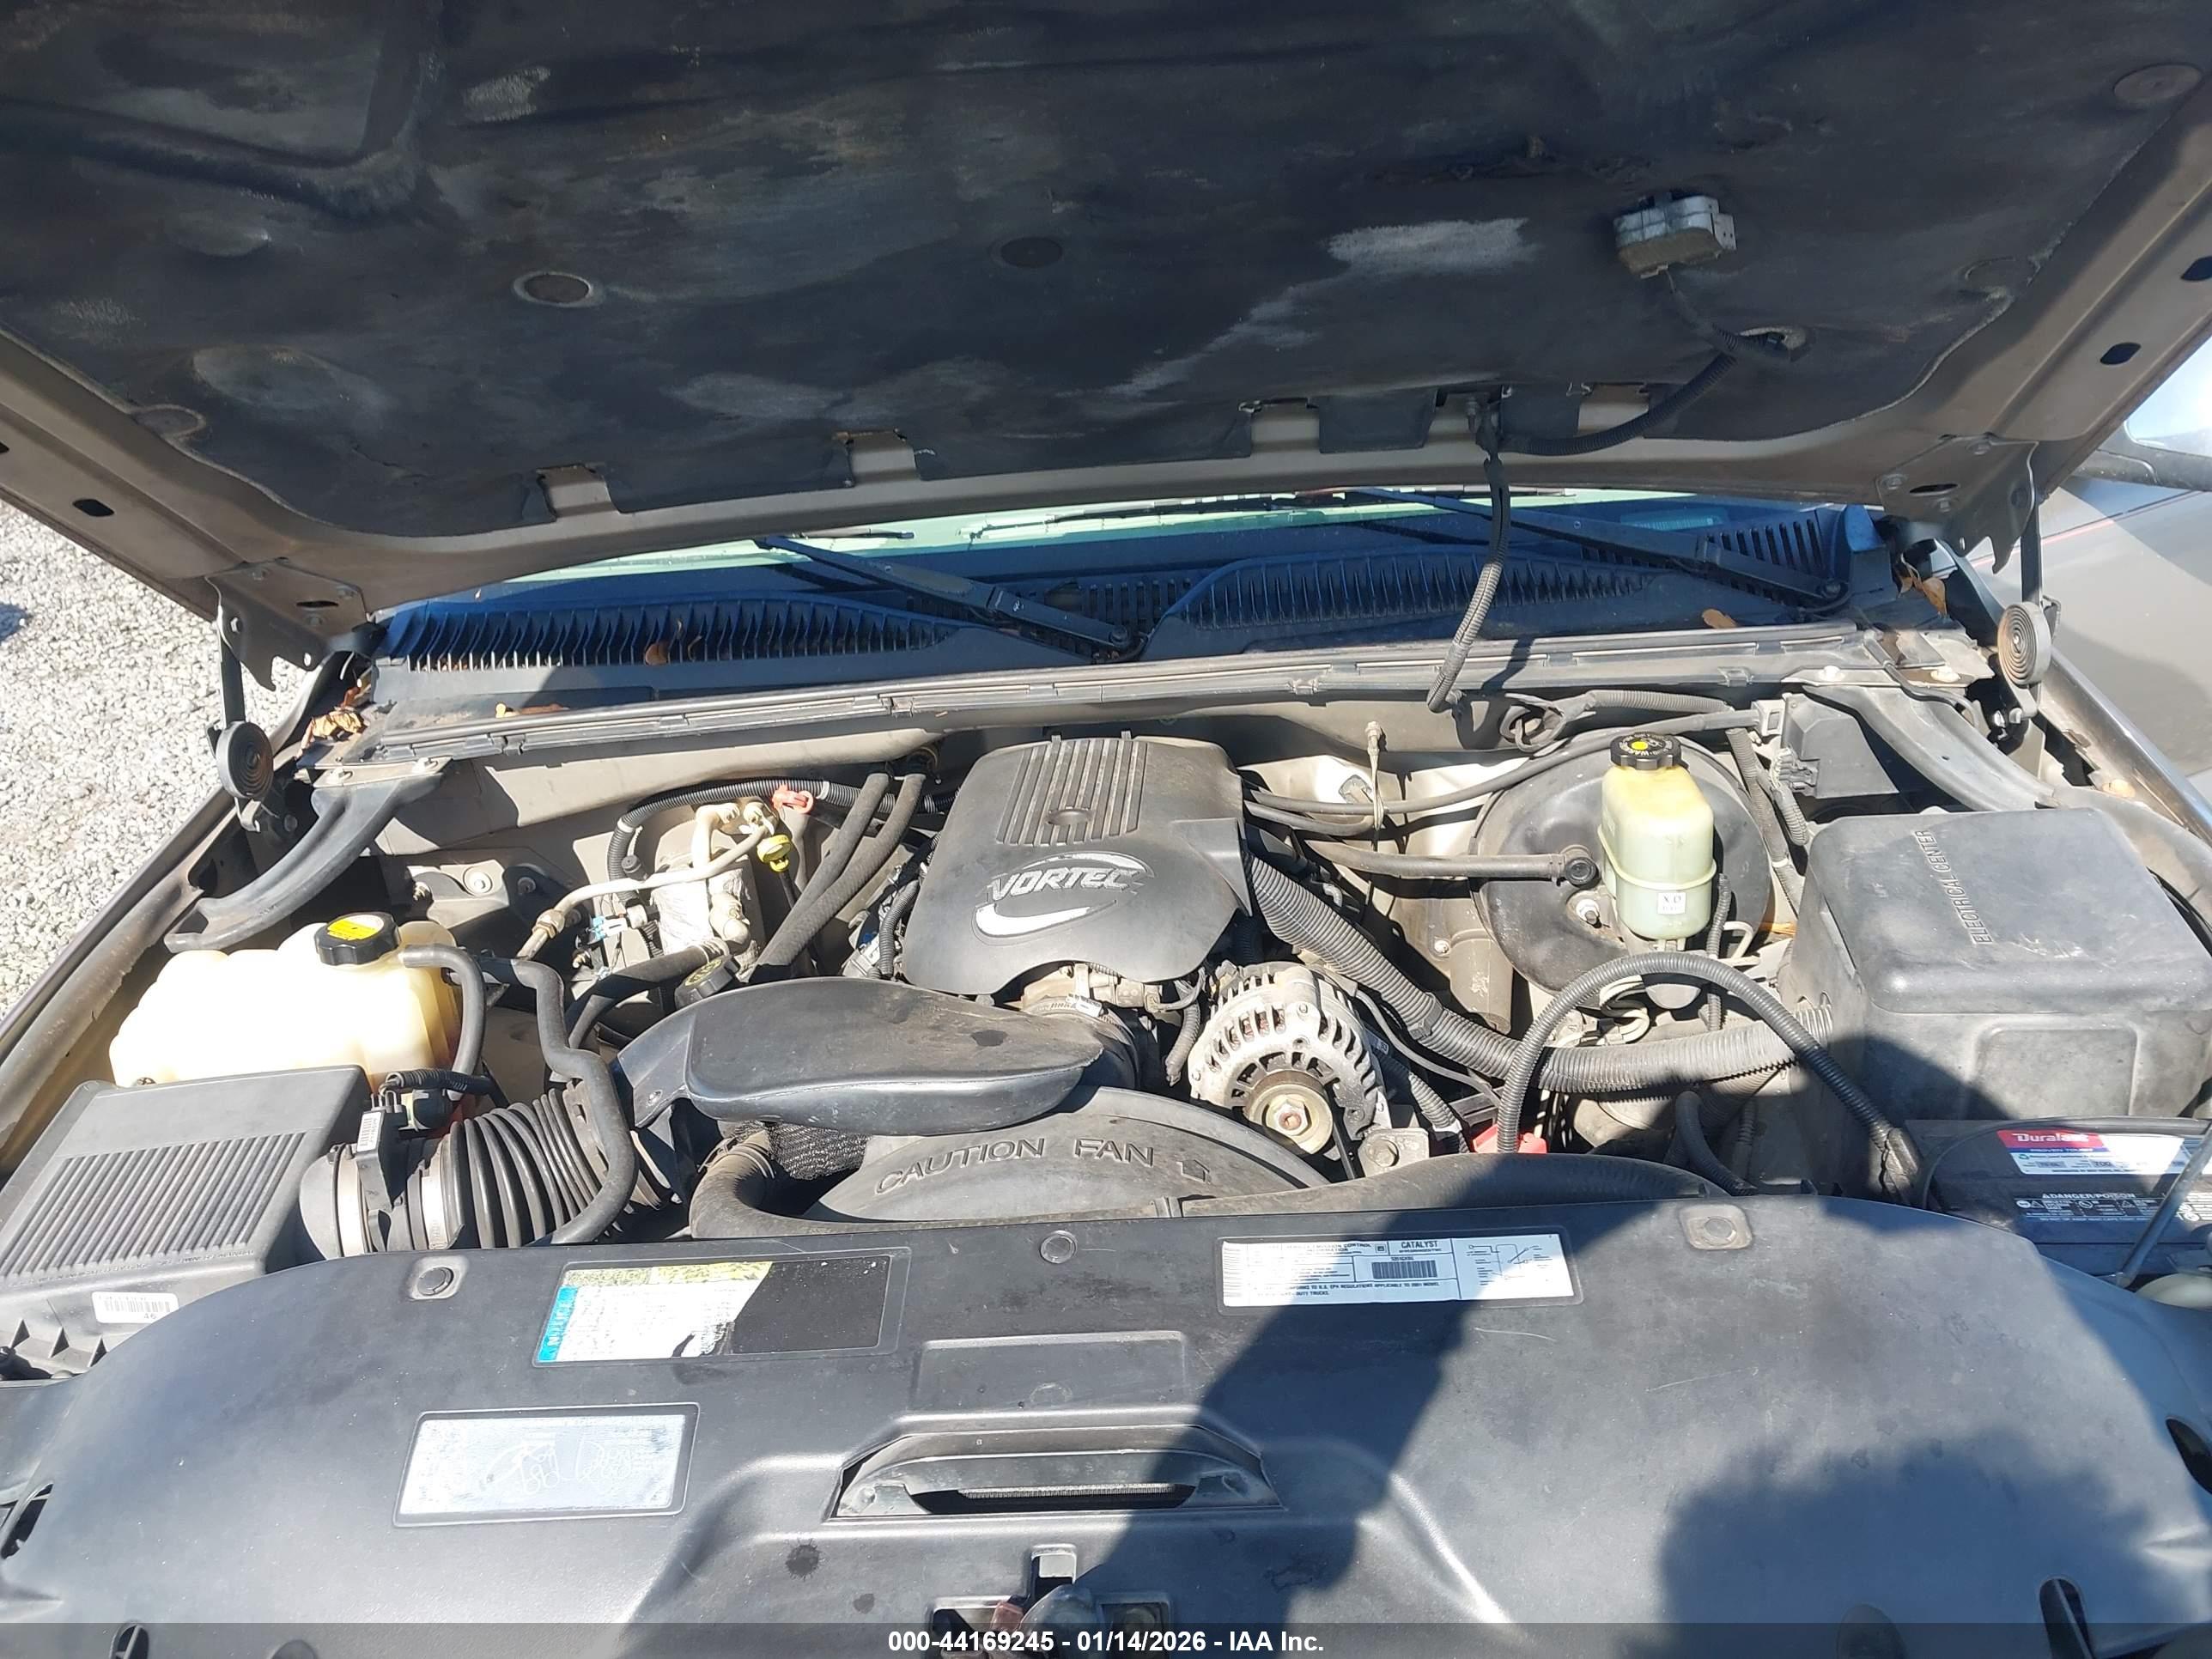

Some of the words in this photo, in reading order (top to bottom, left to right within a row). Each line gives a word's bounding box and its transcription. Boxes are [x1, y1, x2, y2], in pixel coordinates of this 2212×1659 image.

[1913, 830, 1952, 872] CENTER
[988, 866, 1142, 902] VORTEC
[1938, 874, 1993, 945] ELECTRICAL
[874, 1138, 1045, 1194] CAUTION
[1074, 1138, 1154, 1168] FAN
[1401, 1240, 1438, 1249] CATALYST
